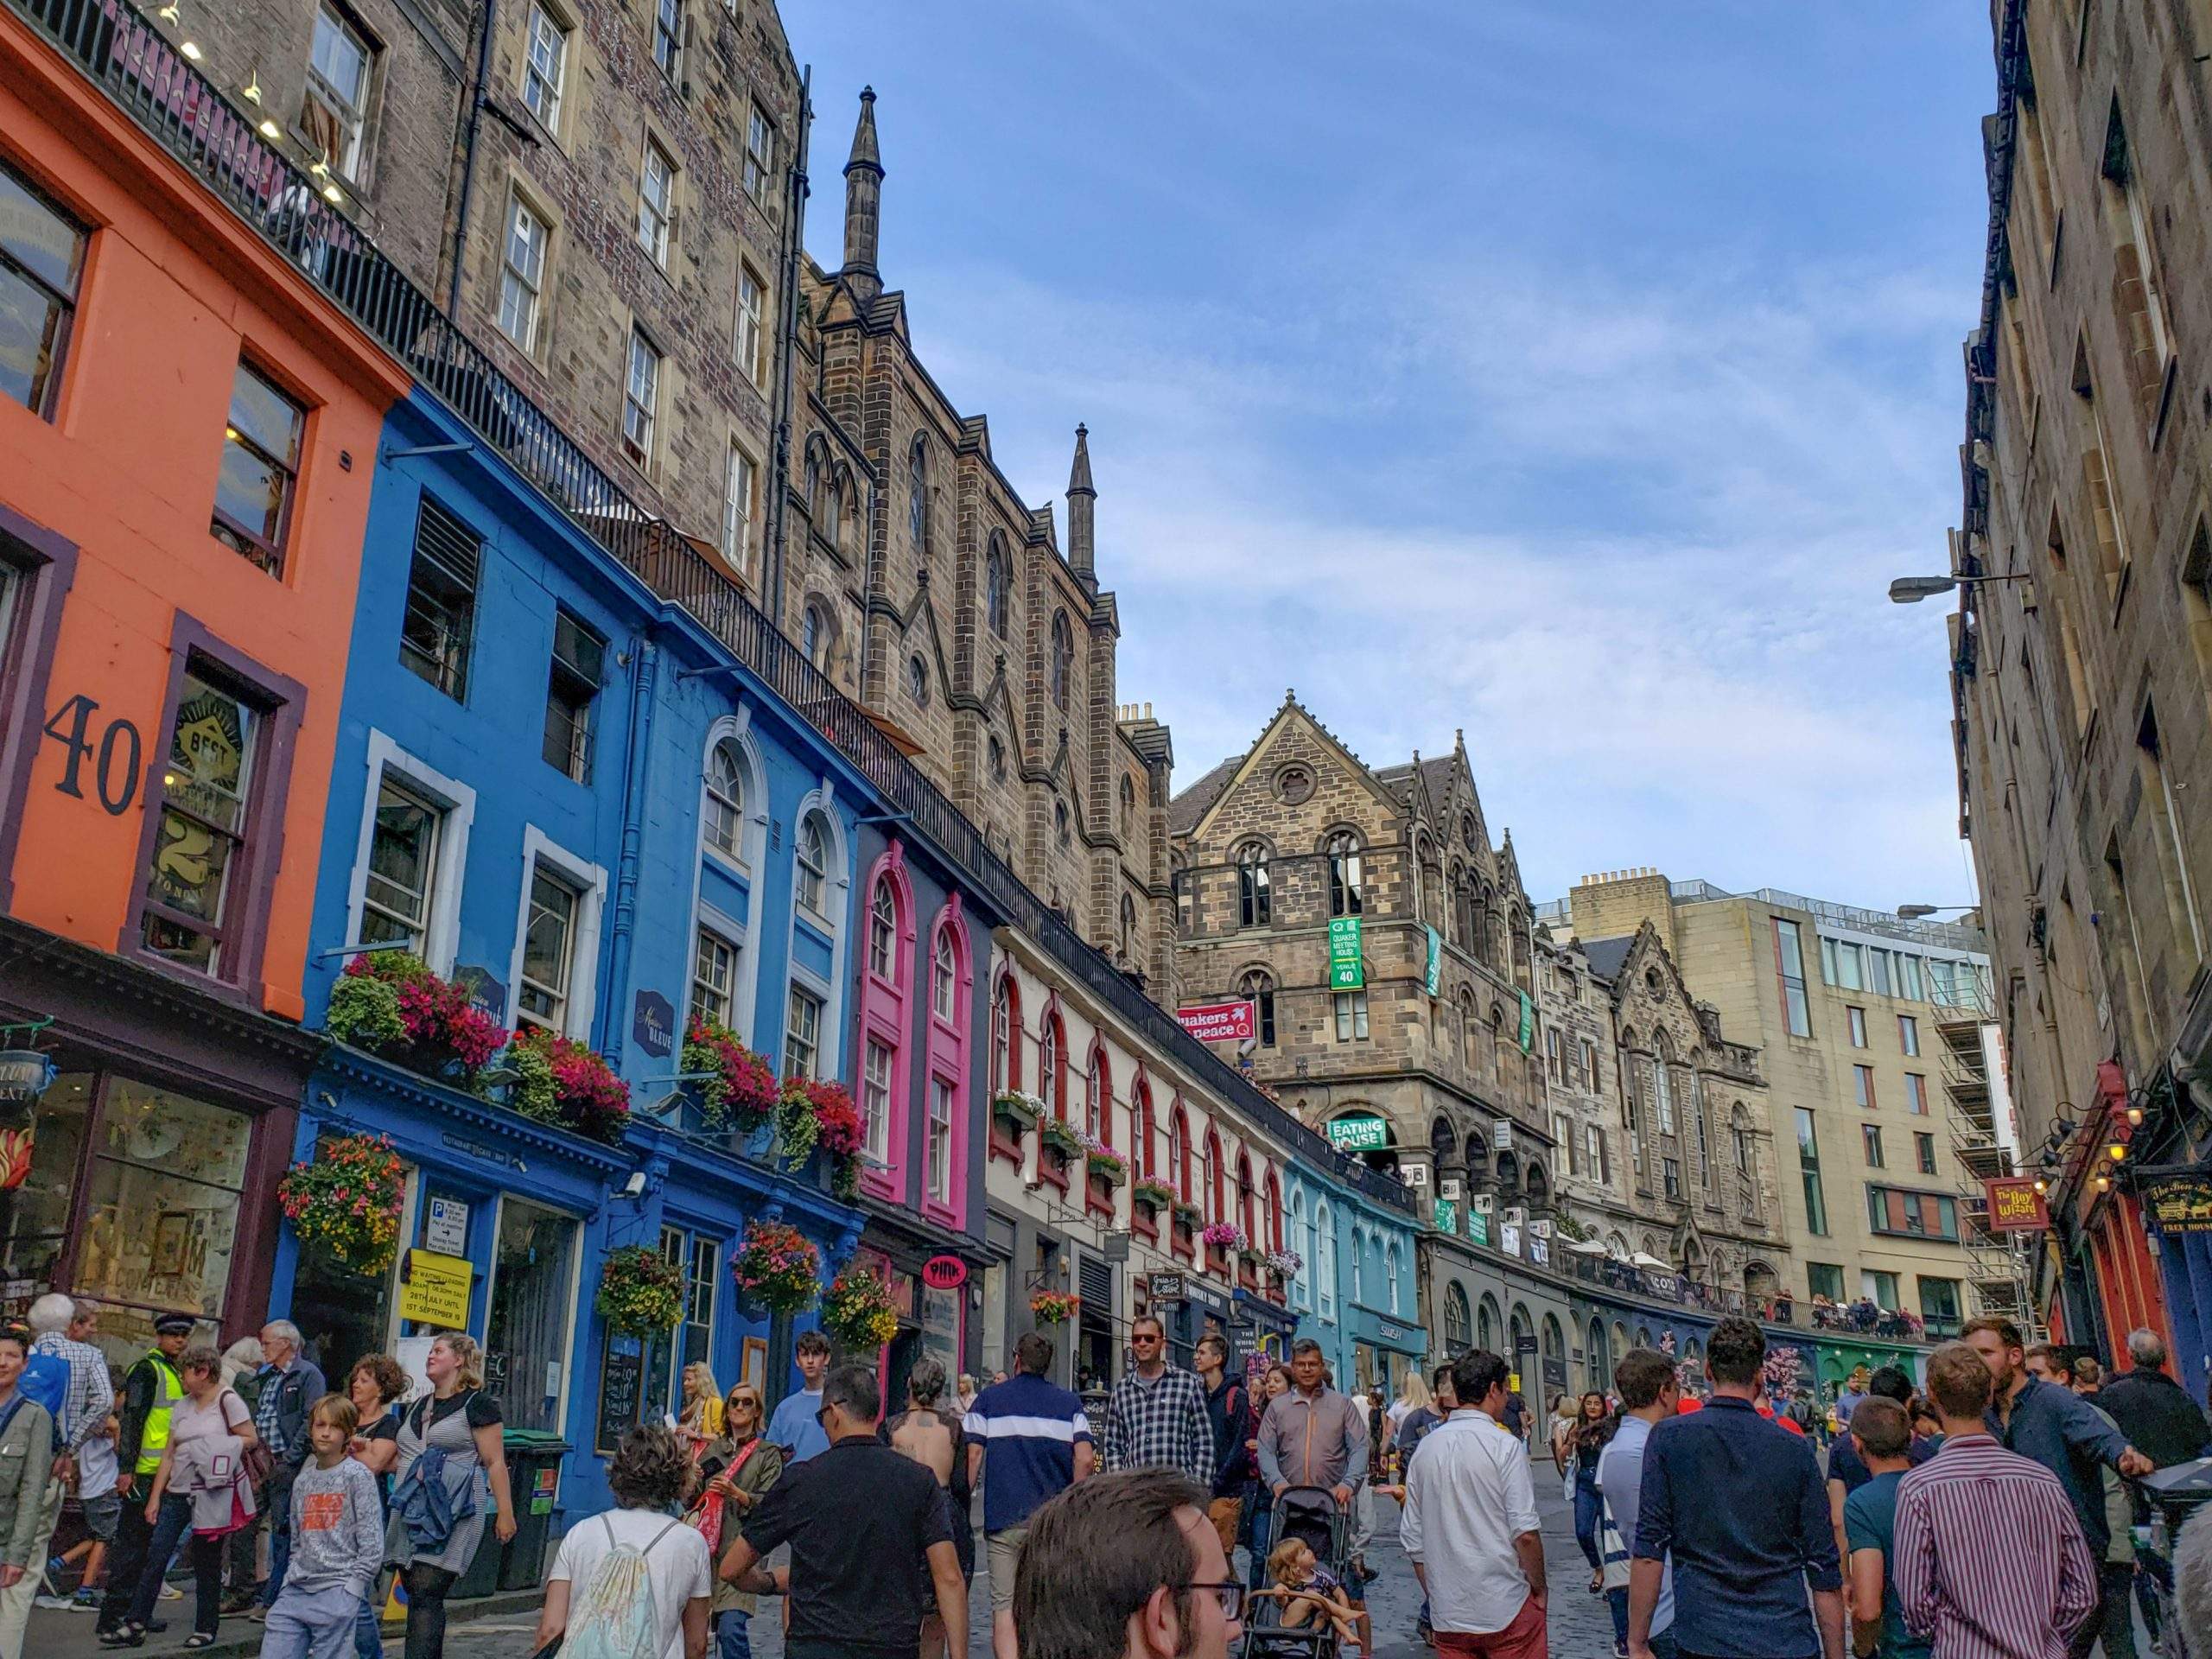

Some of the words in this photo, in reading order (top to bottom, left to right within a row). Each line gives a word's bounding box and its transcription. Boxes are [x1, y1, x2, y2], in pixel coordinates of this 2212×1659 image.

[190, 731, 228, 762] BEST
[44, 694, 141, 815] 40
[1333, 933, 1357, 943] QUAKER
[1333, 941, 1357, 950] MEETING
[1339, 970, 1354, 982] 40
[1177, 1012, 1229, 1027] uakers
[649, 1026, 672, 1051] BLEUE
[1192, 1024, 1235, 1038] peace
[1333, 1120, 1383, 1137] EATING
[1997, 1192, 2010, 1201] The
[2010, 1190, 2033, 1205] Boy
[1998, 1201, 2037, 1217] Wizard
[2163, 1223, 2183, 1233] FREE
[429, 1296, 442, 1305] JULY
[444, 1300, 460, 1310] UNTIL
[1208, 1293, 1221, 1309] SHOP
[418, 1306, 454, 1319] SEPTEMBER
